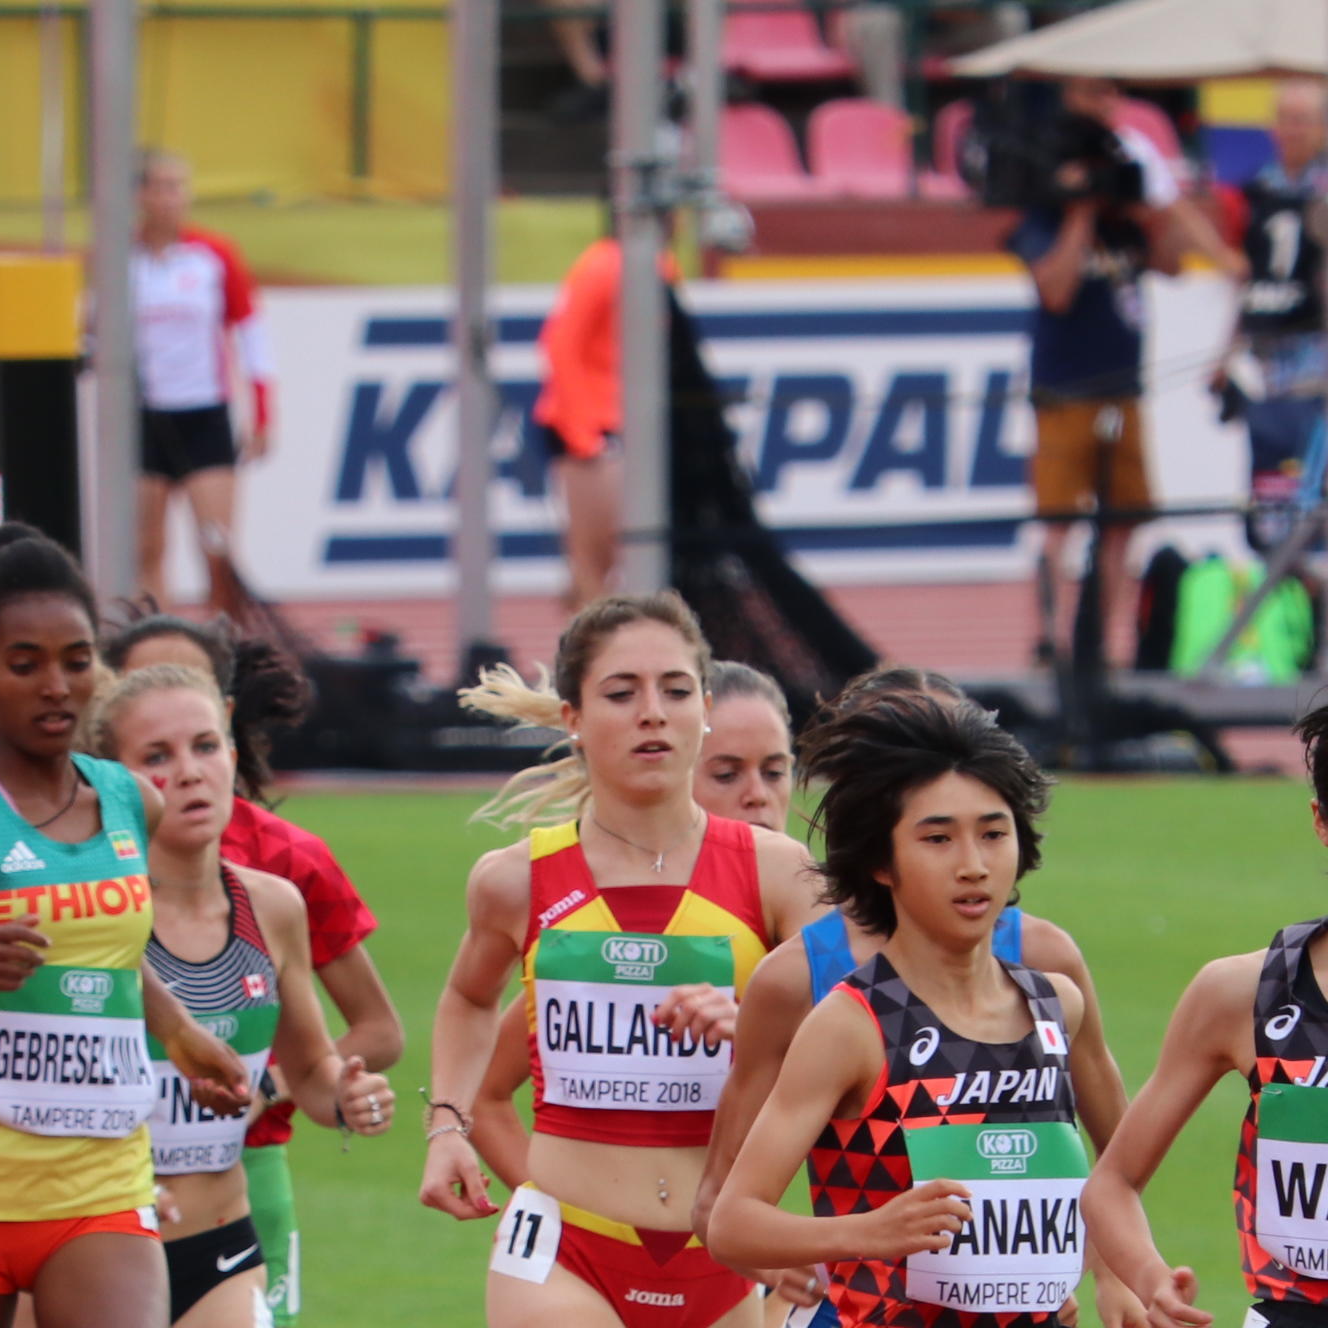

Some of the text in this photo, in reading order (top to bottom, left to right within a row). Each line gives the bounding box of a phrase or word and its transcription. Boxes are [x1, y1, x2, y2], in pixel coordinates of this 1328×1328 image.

[334, 368, 1036, 503] KAPAL
[609, 940, 660, 963] KOTI
[615, 964, 649, 977] PIZZA
[560, 1077, 702, 1104] TAMPERE 2018
[936, 1066, 1059, 1107] JAPAN
[11, 1104, 96, 1131] TAMPERE
[983, 1133, 1031, 1155] KOTI
[990, 1158, 1023, 1170] PIZZA
[507, 1209, 543, 1260] 11
[927, 1197, 1078, 1256] ANAKA
[936, 1280, 1067, 1305] TAMPERE 2018
